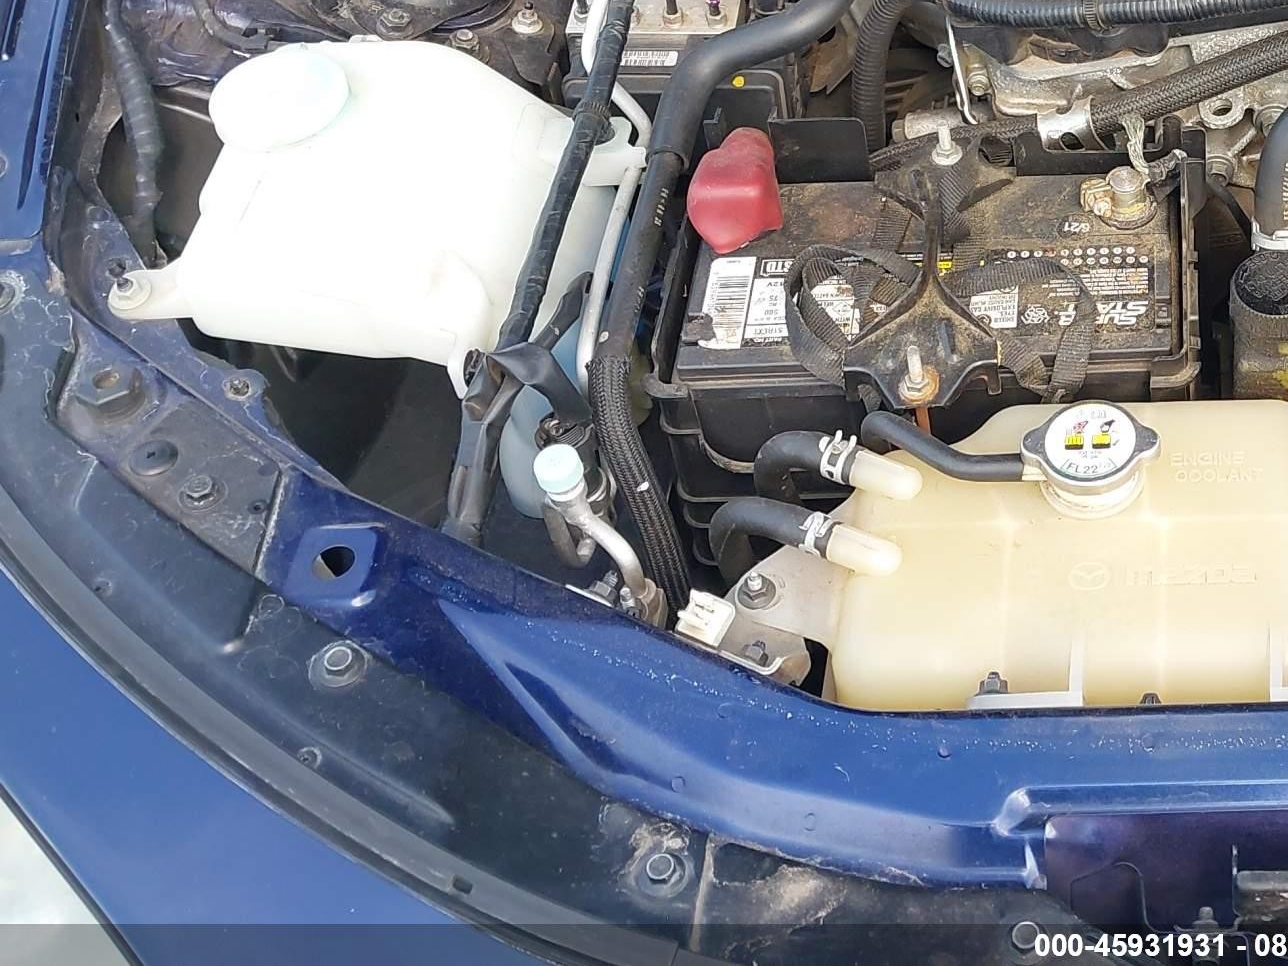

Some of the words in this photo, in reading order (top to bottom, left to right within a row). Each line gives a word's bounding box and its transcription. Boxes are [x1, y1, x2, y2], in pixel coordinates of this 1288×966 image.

[1063, 221, 1090, 233] 6/21
[1170, 451, 1246, 467] ENGINE
[1176, 467, 1264, 483] COOLANT
